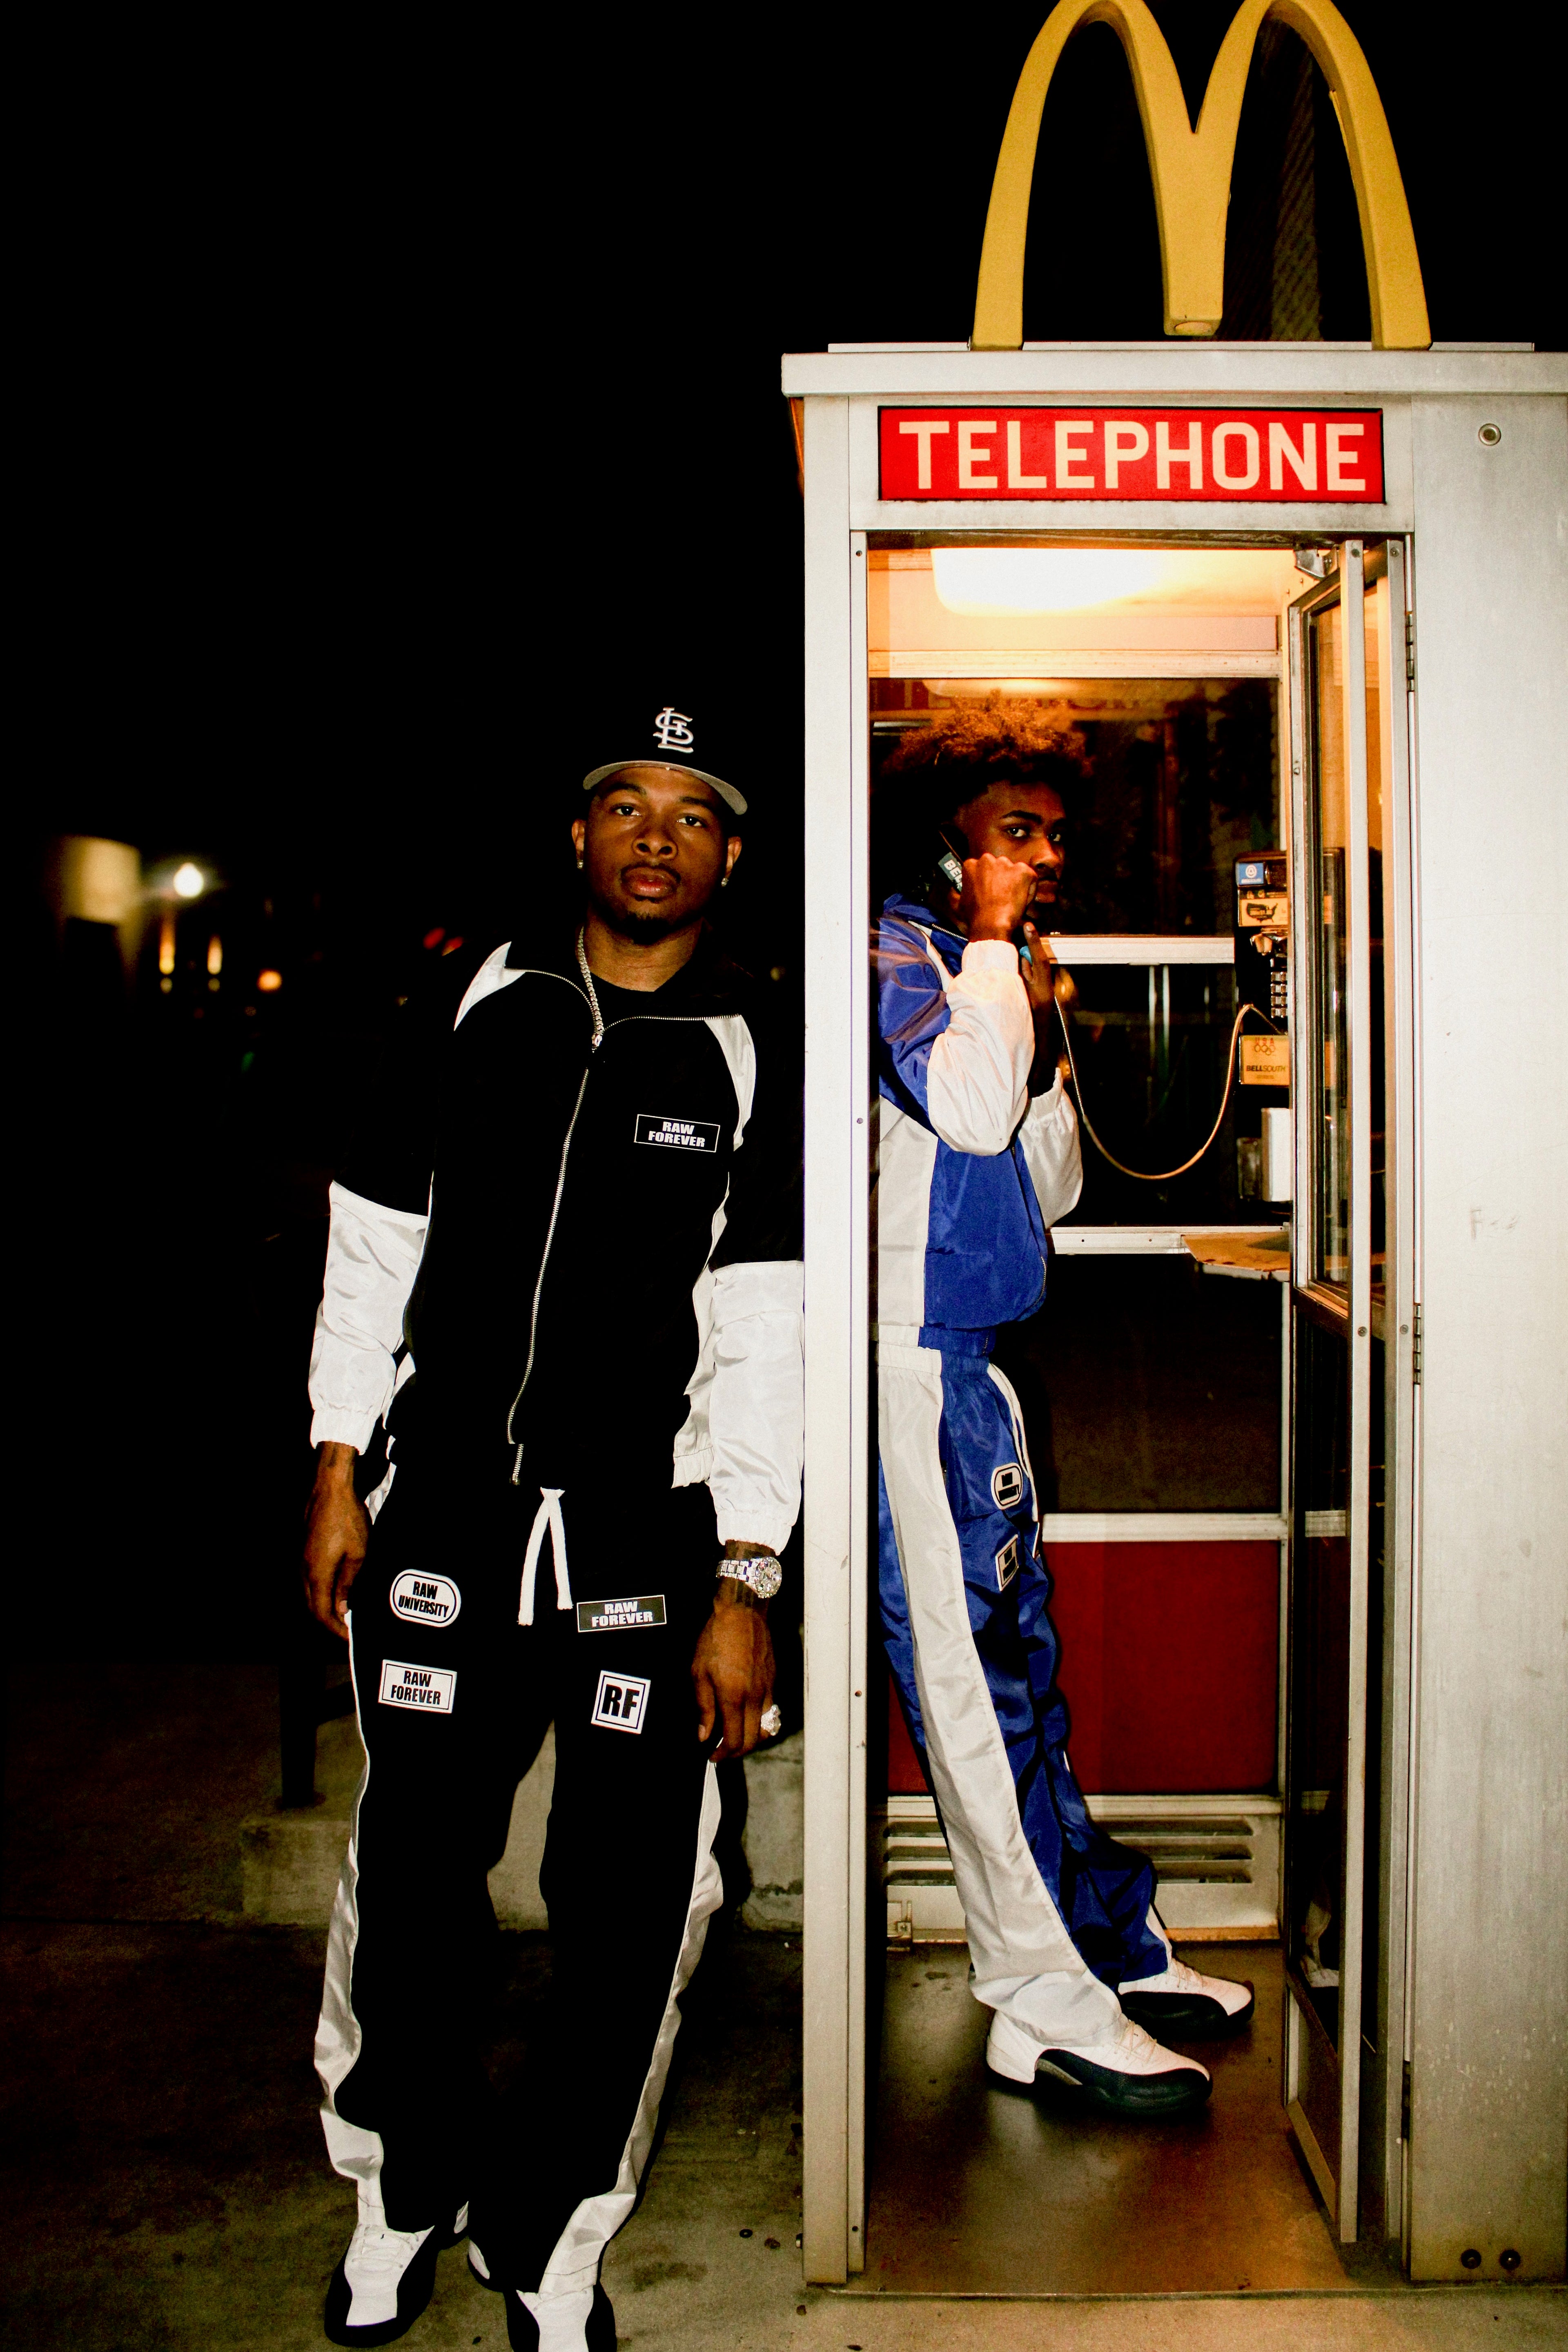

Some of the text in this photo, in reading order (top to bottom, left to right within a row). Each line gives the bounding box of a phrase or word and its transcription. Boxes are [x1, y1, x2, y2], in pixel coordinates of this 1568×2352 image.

[899, 421, 1366, 492] TELEPHONE
[662, 1121, 695, 1135] RAW
[648, 1131, 705, 1147] FOREVER
[412, 1581, 438, 1599] RAW
[398, 1595, 450, 1617] UNIVERSITY
[604, 1601, 638, 1615] RAW
[592, 1611, 653, 1627] FOREVER
[403, 1670, 432, 1687] RAW
[391, 1685, 441, 1705] FOREVER
[601, 1684, 640, 1719] RF
